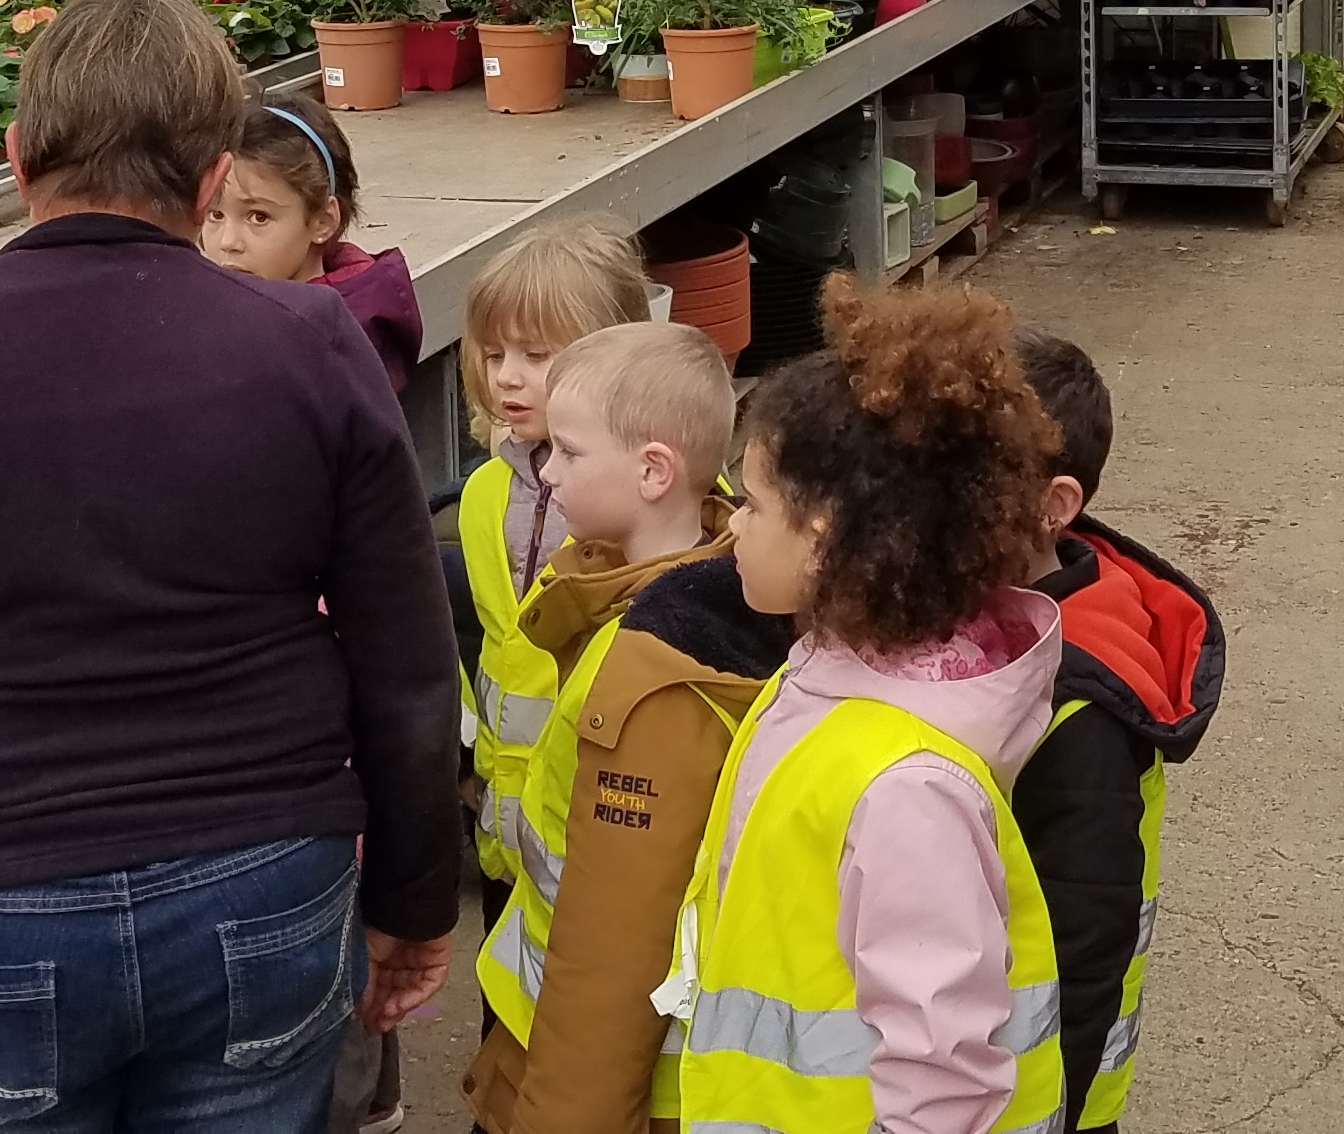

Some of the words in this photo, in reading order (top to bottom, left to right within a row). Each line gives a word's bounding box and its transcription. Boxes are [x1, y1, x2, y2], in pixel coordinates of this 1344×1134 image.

[597, 770, 659, 797] REBEL
[601, 787, 645, 811] YOUTH
[593, 801, 652, 830] RIDER
